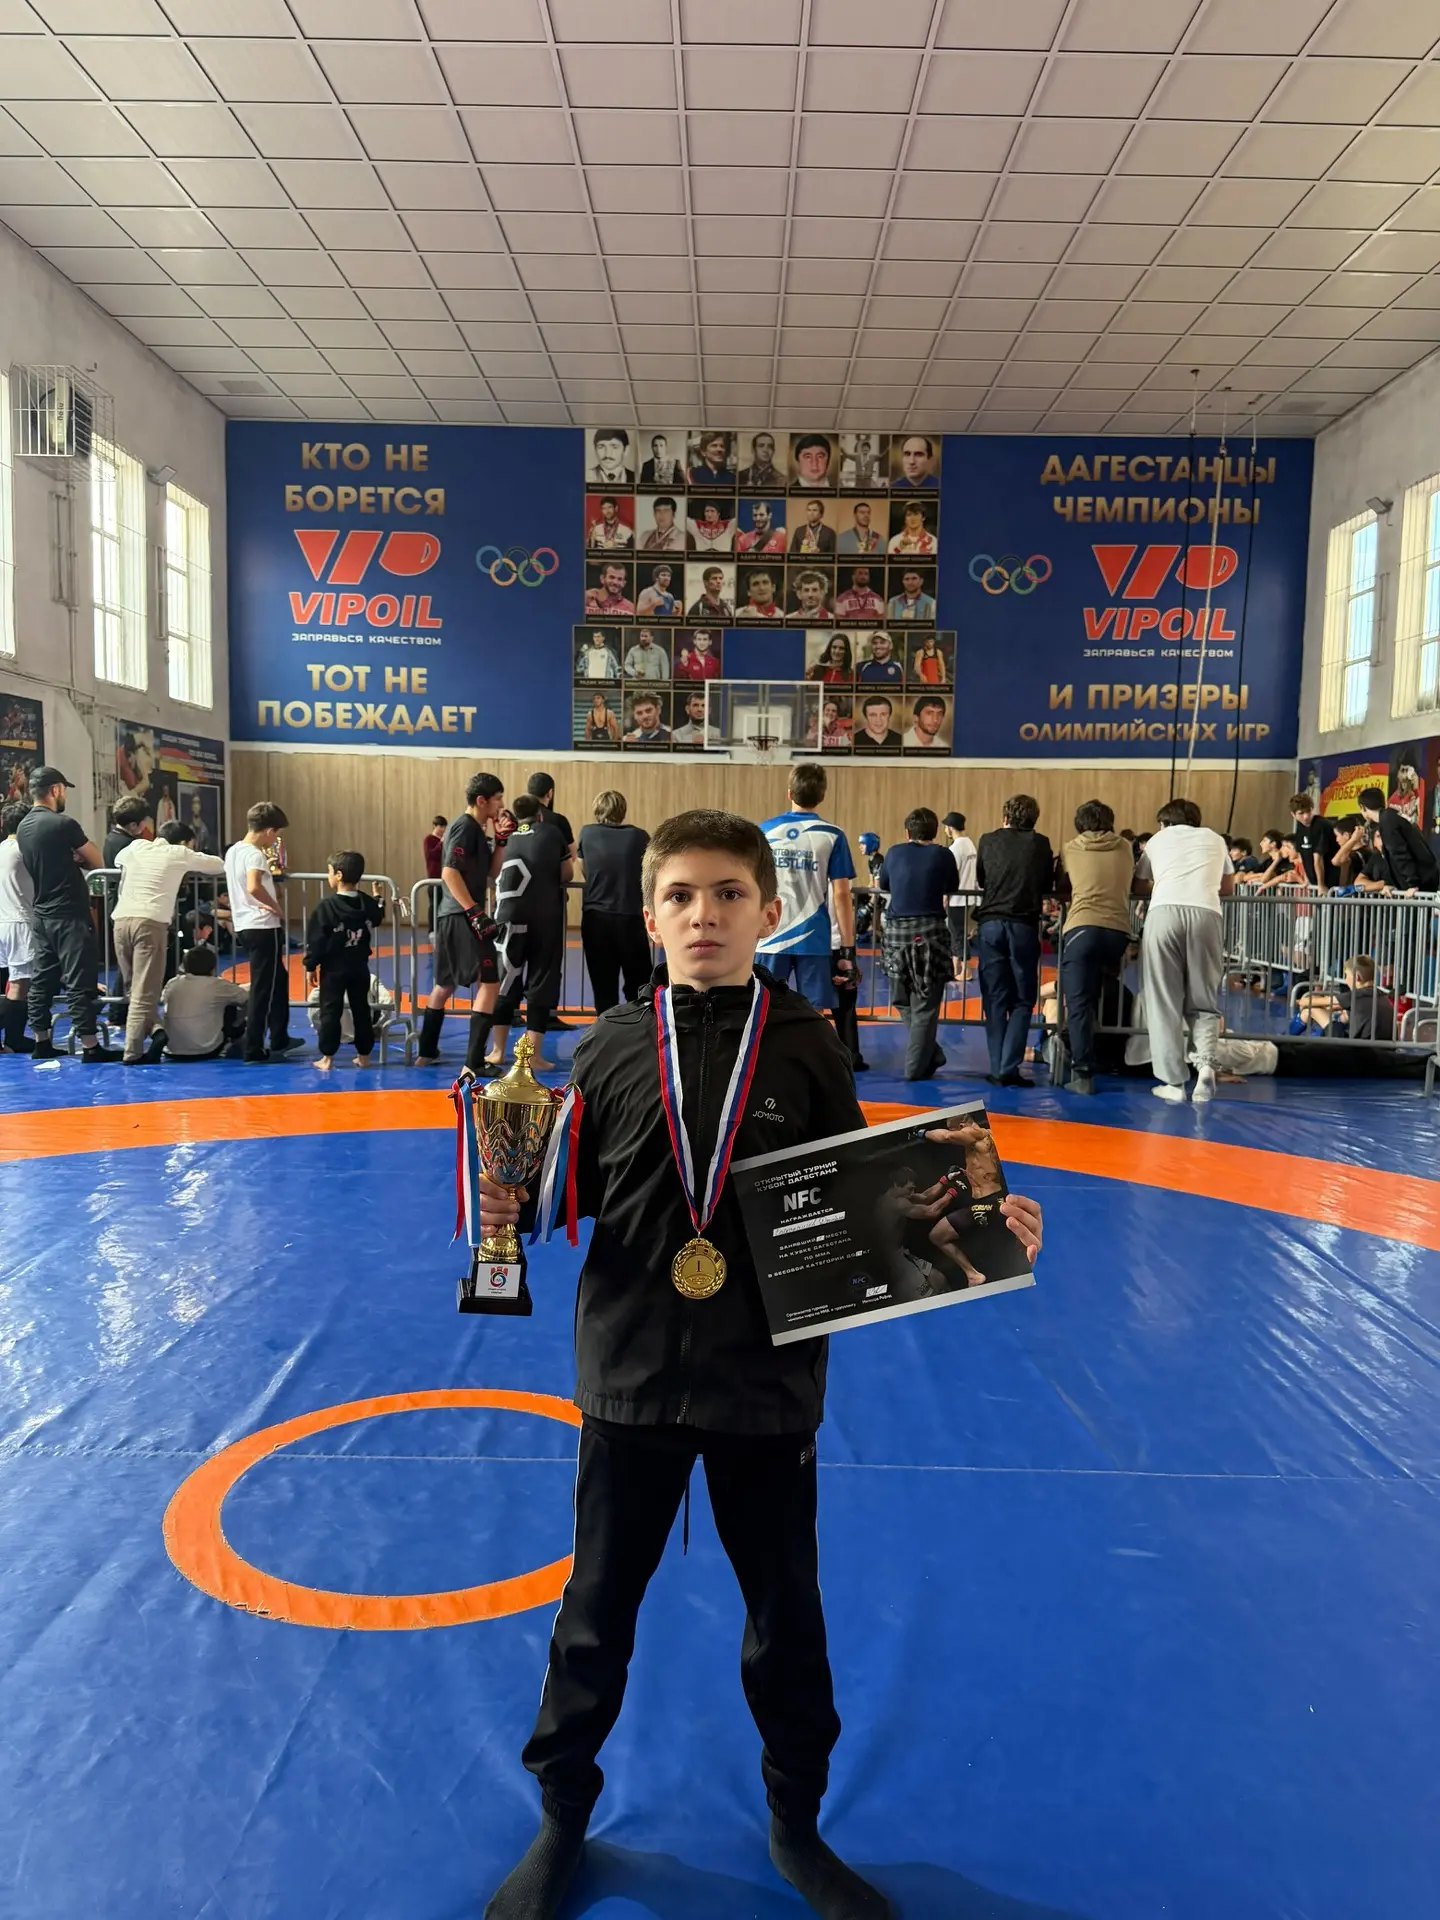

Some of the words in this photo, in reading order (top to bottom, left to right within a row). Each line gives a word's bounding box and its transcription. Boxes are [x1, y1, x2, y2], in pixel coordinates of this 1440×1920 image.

[301, 442, 371, 471] КТО
[384, 444, 429, 472] НЕ
[1040, 454, 1276, 487] ДАГЕСТАНЦЫ
[284, 484, 445, 516] БОРЕТСЯ
[1052, 496, 1260, 525] ЧЕМПИОНЫ
[288, 591, 443, 629] VIPOIL
[1083, 607, 1237, 641] VIPOIL
[291, 632, 364, 643] ЗАПРАВЬСЯ
[368, 635, 442, 646] КАЧЕСТВОМ
[1083, 648, 1155, 657] ЗАПРАВЬСЯ
[306, 663, 371, 692] ТОТ
[384, 666, 428, 694] НЕ
[1049, 684, 1073, 710] И
[1087, 683, 1249, 711] ПРИЗЕРЫ
[257, 700, 477, 736] ПОБЕЖДАЕТ
[1019, 718, 1217, 742] ОЛИМПИЙСКИХ
[1226, 722, 1271, 742] ИГР
[774, 857, 819, 872] ESTLING
[752, 1110, 785, 1123] JOMOTO
[754, 1169, 802, 1187] ОТКРЫТЫЙ
[803, 1160, 838, 1174] ТУРНИР
[756, 1180, 786, 1193] КУБОК
[787, 1167, 838, 1185] ДАГЕСТАНА
[783, 1186, 822, 1213] NFC
[780, 1207, 834, 1225] НАГРАЖДАЕТСЯ
[813, 1237, 852, 1250] ДАГЕСТАНА
[825, 1229, 848, 1240] МЕСТО
[805, 1256, 845, 1269] КАТЕГОРИИ
